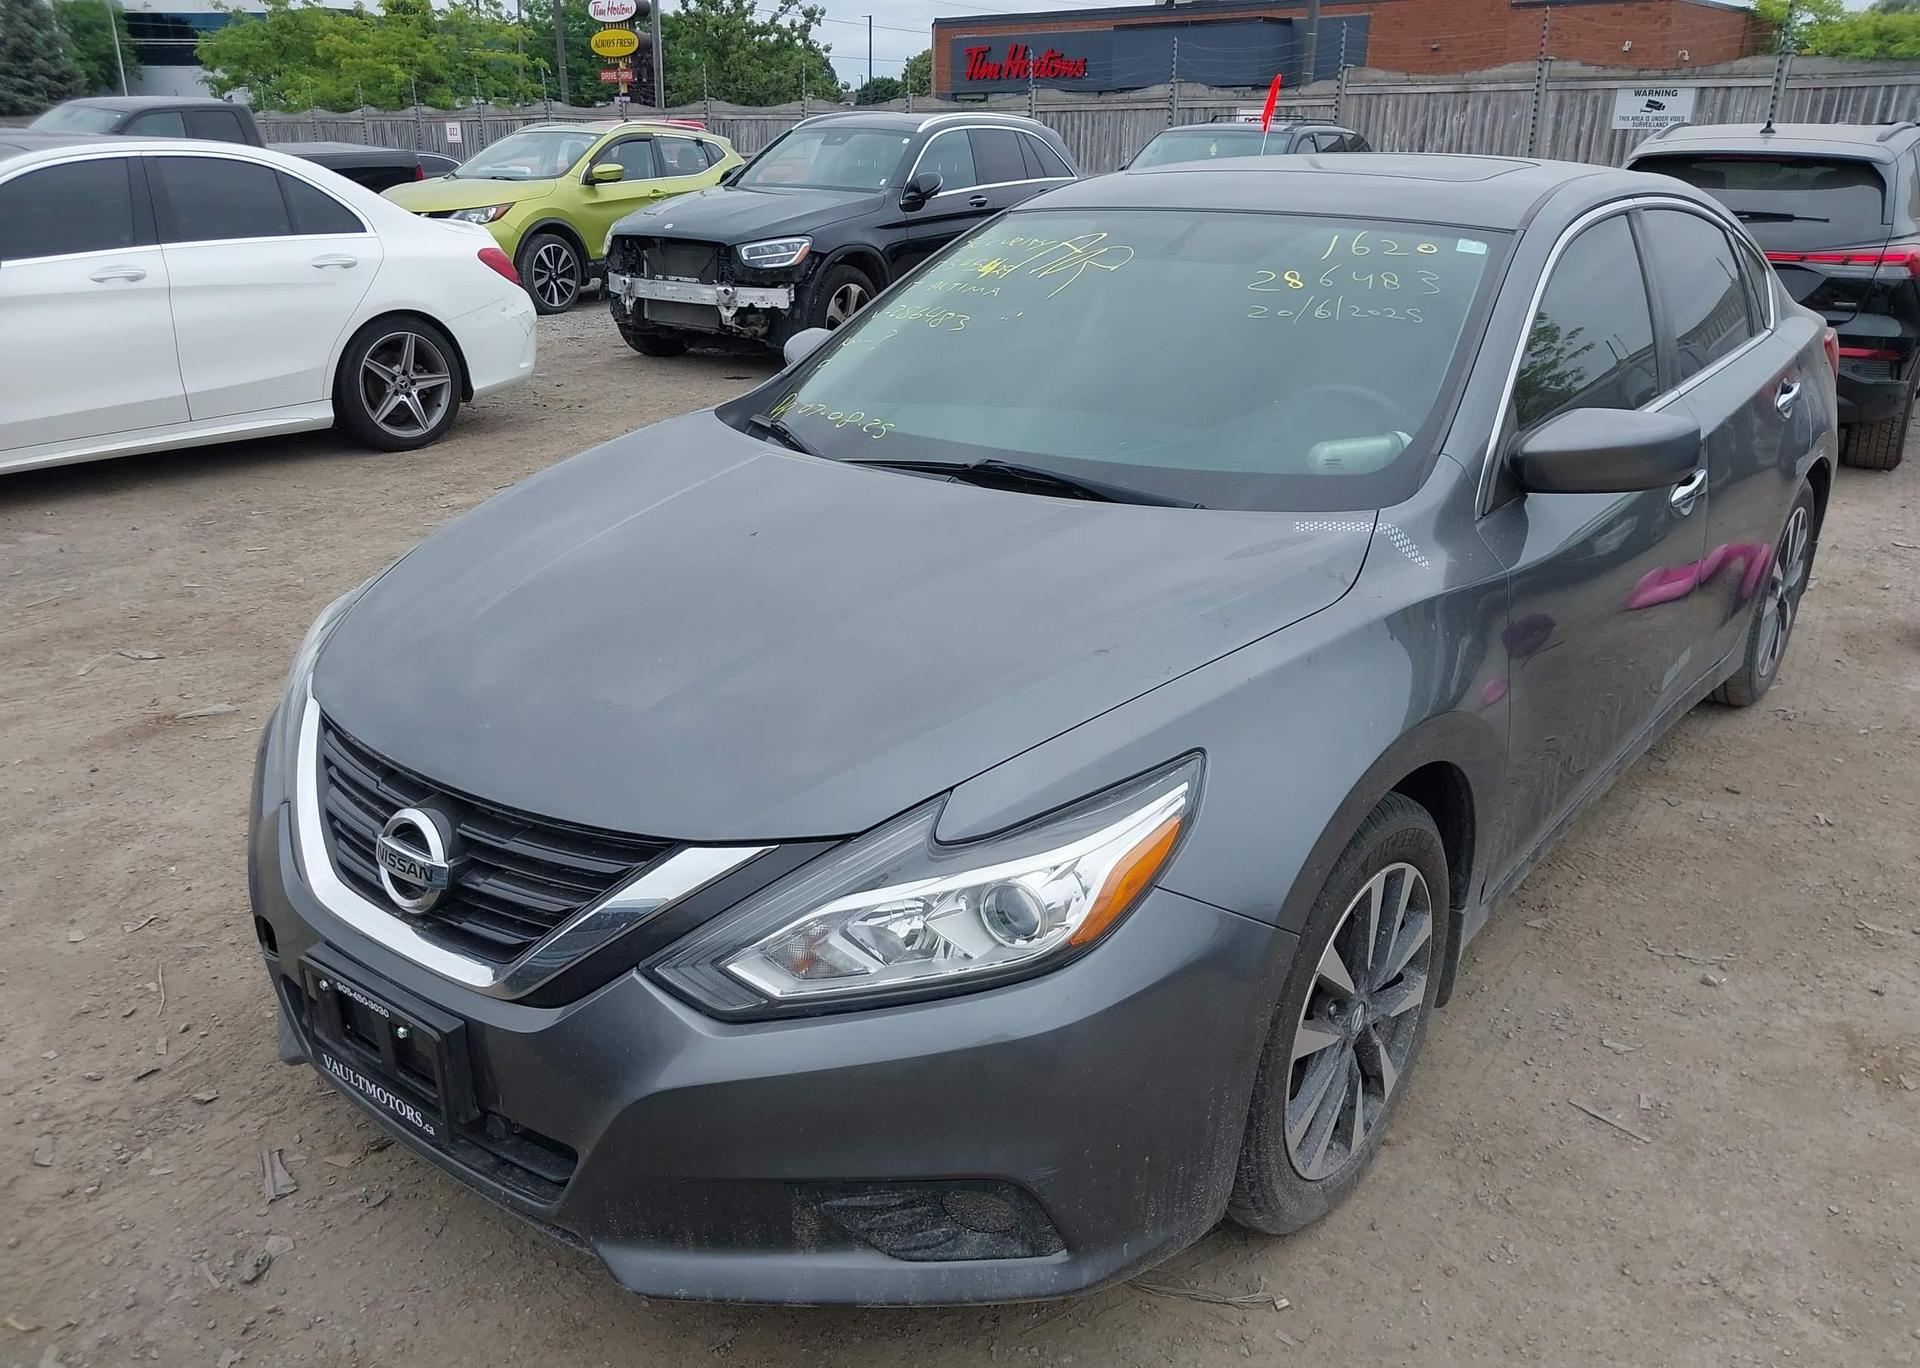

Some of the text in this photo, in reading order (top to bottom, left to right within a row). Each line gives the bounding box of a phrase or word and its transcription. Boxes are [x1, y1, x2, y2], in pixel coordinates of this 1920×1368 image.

[592, 0, 633, 17] Tim Hortons
[594, 38, 635, 49] ALWAYS FRESH
[964, 43, 1088, 81] Tim Hortons
[1633, 89, 1678, 97] WARNING
[1321, 230, 1438, 260] 1620
[380, 848, 434, 883] NISSAN
[322, 1053, 436, 1136] VAULTMOTORS.ca
